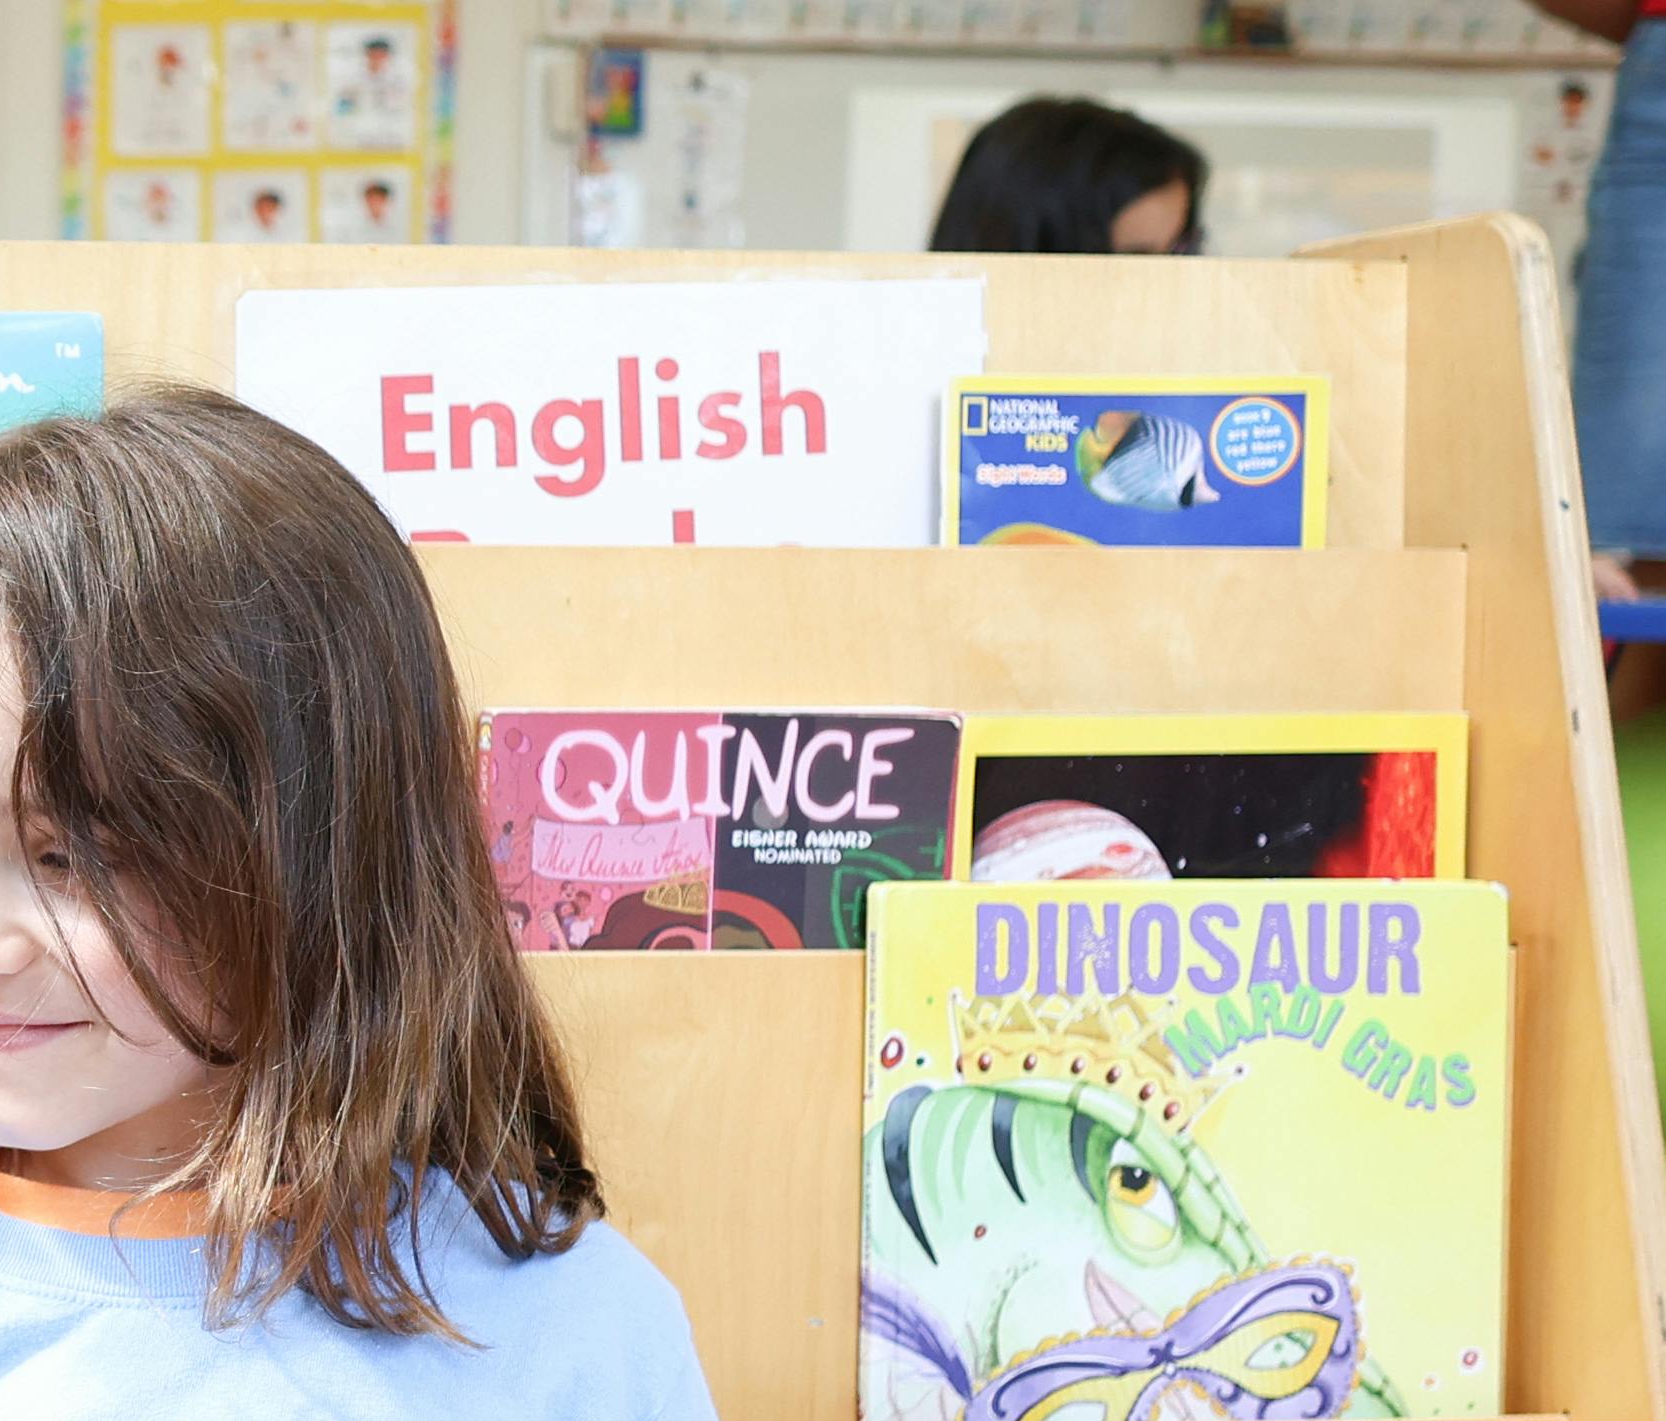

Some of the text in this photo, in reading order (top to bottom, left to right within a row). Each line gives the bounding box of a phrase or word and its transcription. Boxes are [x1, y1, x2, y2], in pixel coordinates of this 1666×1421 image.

[380, 350, 828, 504] English
[989, 399, 1059, 415] NATIONAL
[989, 415, 1079, 434] GEOGRAPHIC
[542, 718, 915, 825] QUINCE
[732, 829, 873, 850] EISNER AWARD
[754, 848, 842, 864] NOMINATED
[975, 902, 1421, 996] DINOSAUR
[1163, 982, 1346, 1079] MARDI
[1343, 1018, 1476, 1111] GRAS
